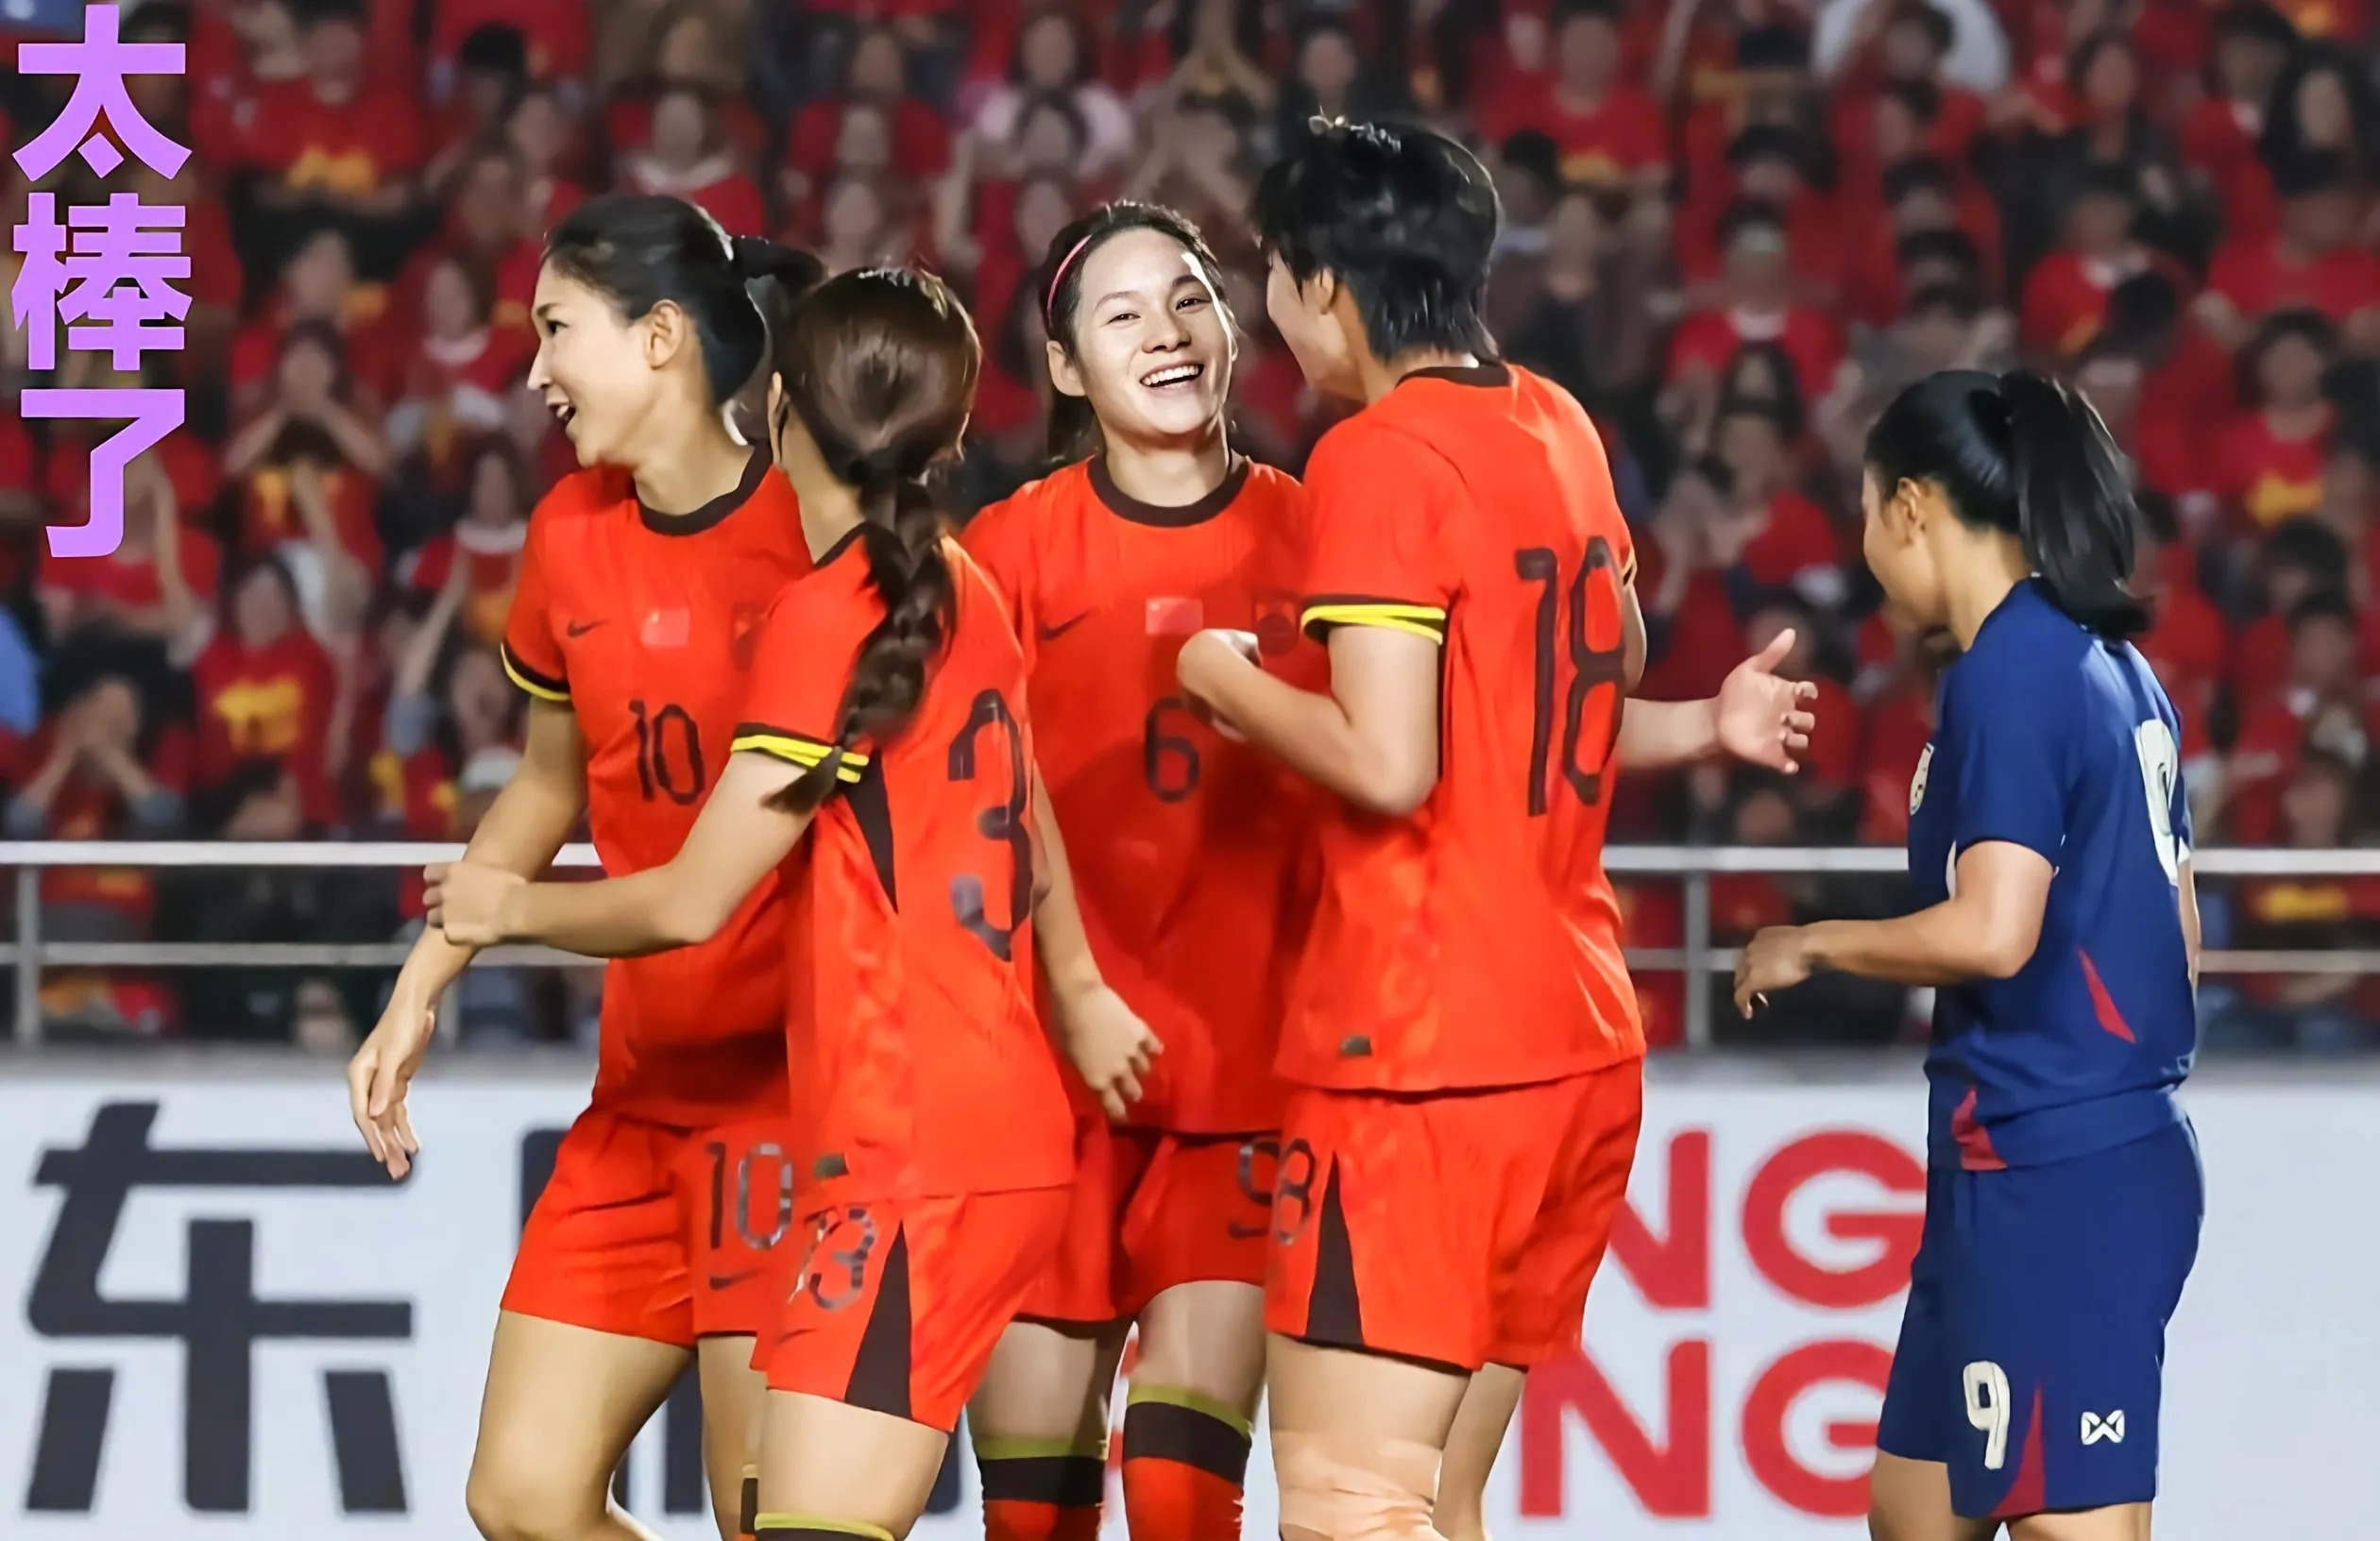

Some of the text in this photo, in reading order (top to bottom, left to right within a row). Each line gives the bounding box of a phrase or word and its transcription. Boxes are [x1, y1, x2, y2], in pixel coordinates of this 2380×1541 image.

[1515, 535, 1626, 818] 18
[628, 699, 706, 806] 10
[1145, 696, 1199, 803] 6
[948, 688, 1034, 962] 3
[706, 1141, 793, 1250] 10
[1964, 1360, 2011, 1470] 9
